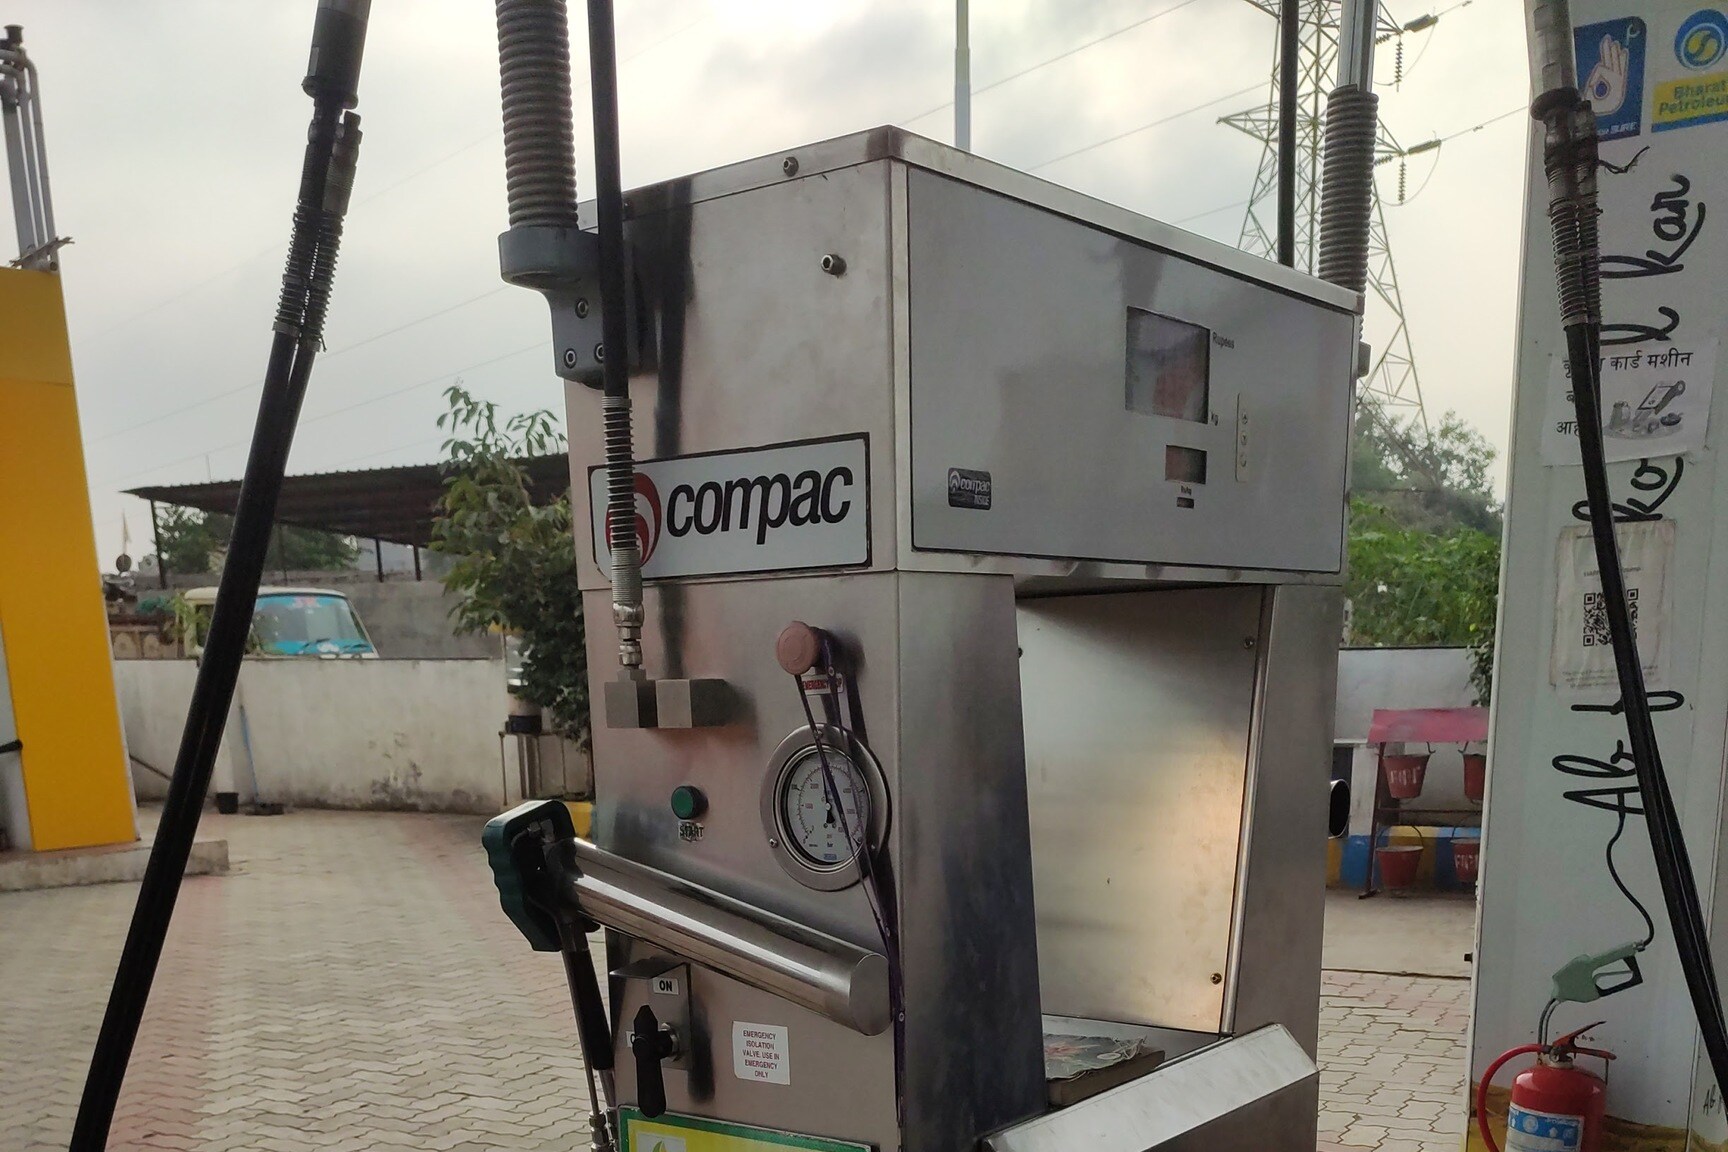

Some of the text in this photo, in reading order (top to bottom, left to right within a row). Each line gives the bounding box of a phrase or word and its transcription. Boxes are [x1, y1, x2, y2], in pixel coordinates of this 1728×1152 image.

[1674, 79, 1726, 99] Bharat
[1610, 349, 1643, 371] कार्ड
[1647, 347, 1694, 369] मशीन
[961, 478, 990, 495] compac
[666, 465, 854, 546] compac
[659, 980, 673, 992] ON
[743, 1030, 777, 1040] EMERGENCY
[746, 1040, 775, 1050] ISOLATION
[762, 1052, 773, 1060] USE
[745, 1059, 778, 1070] EMERGENCY
[755, 1070, 769, 1078] ONLY
